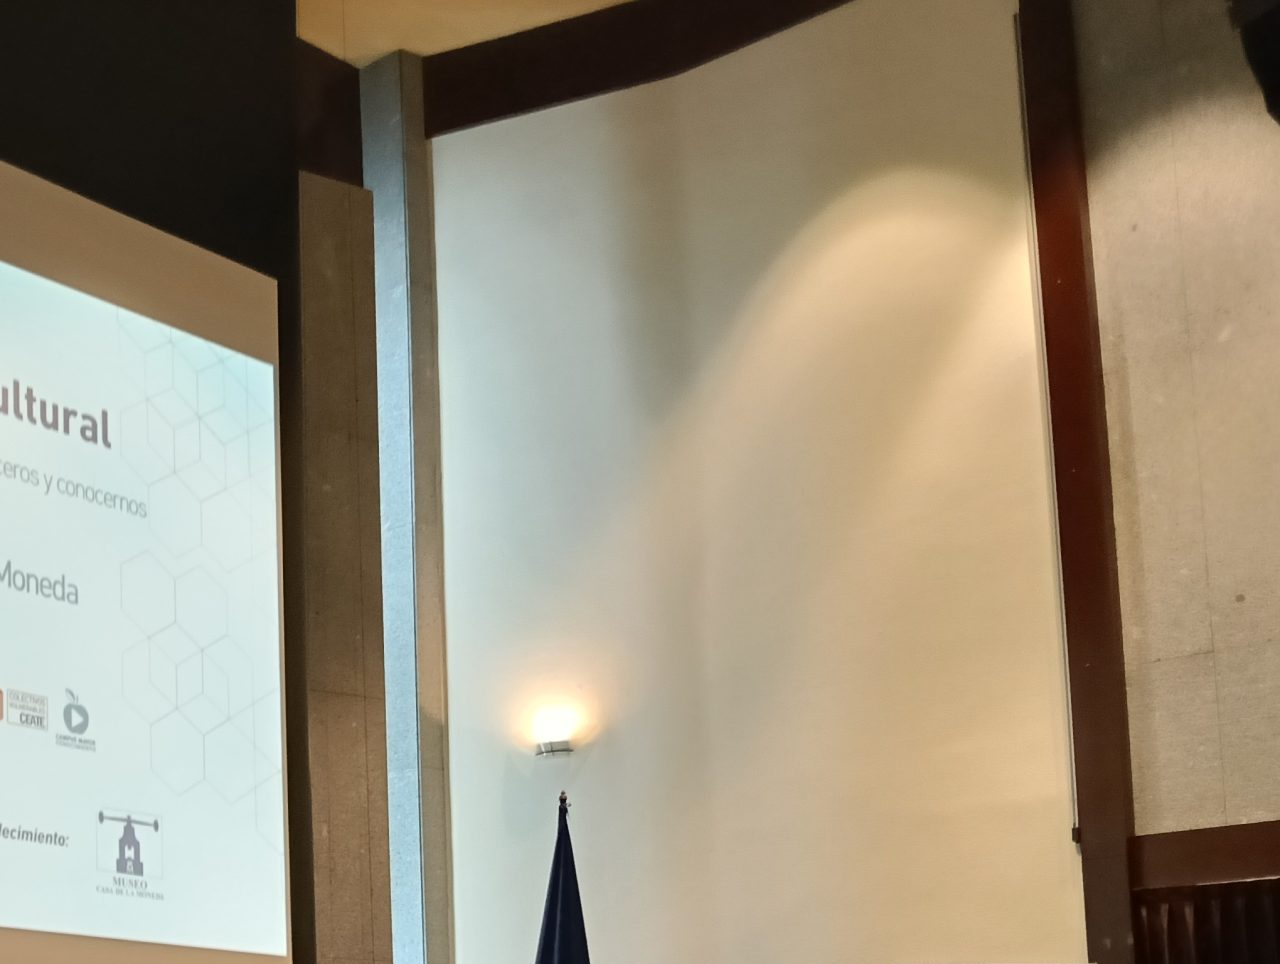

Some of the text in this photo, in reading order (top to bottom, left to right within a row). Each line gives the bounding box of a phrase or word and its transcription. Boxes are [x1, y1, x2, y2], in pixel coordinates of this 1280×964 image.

[43, 471, 53, 494] y
[56, 477, 148, 518] conocernos
[20, 712, 46, 729] CEATE
[112, 876, 148, 890] MUSEO
